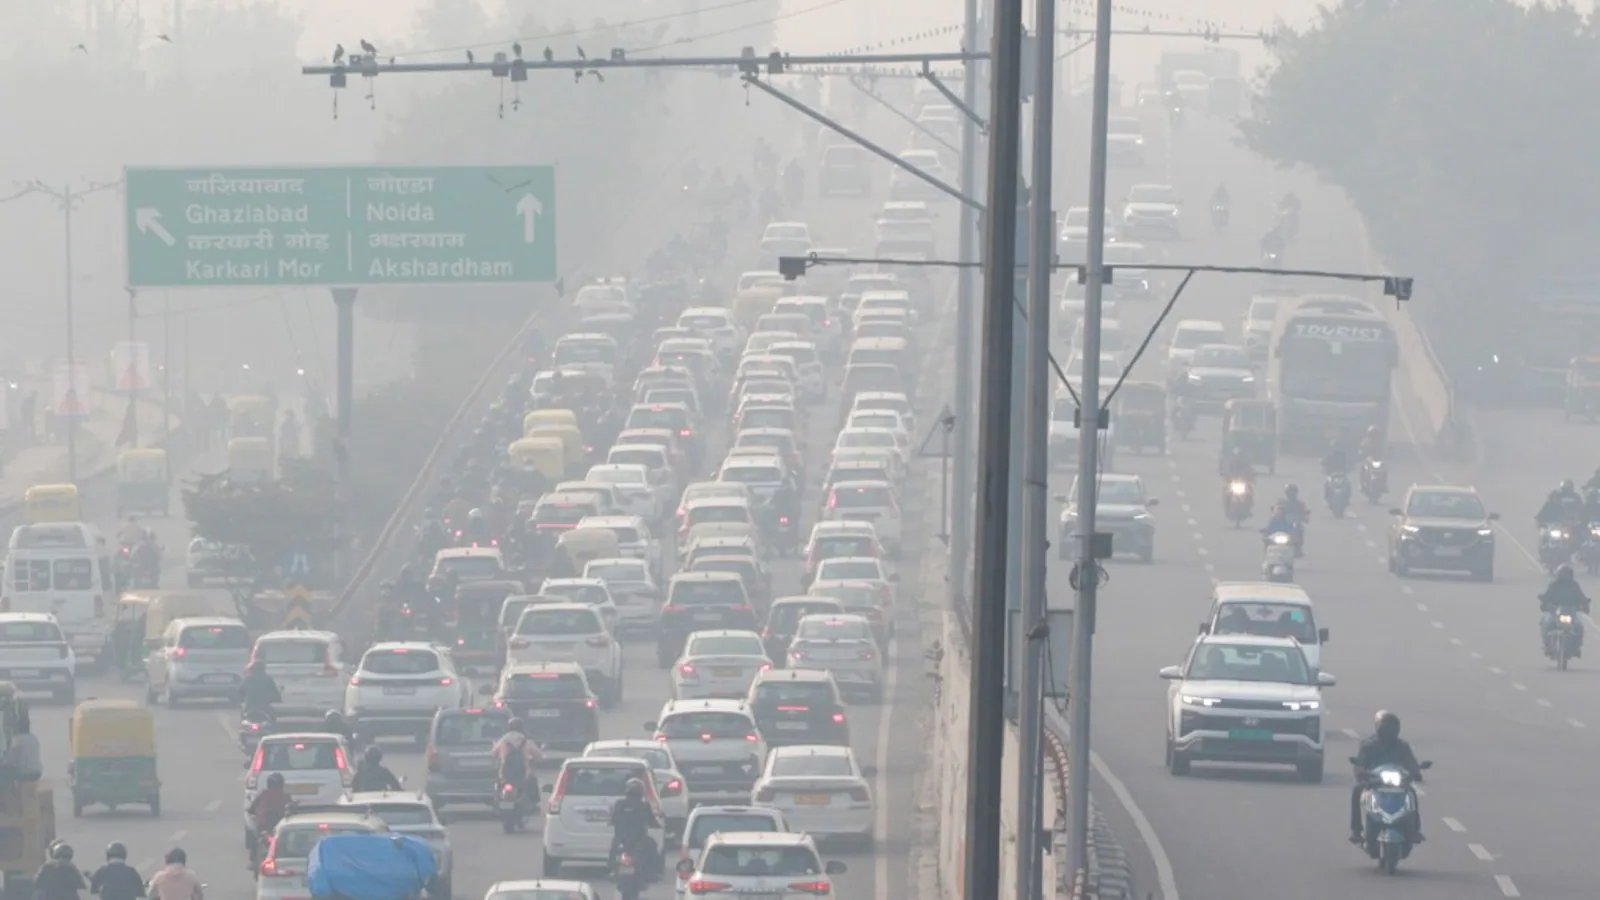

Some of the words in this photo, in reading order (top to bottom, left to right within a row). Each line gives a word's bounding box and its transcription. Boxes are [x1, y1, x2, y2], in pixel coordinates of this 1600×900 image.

[185, 203, 309, 224] Ghaziabad
[367, 202, 435, 222] Noida
[186, 258, 269, 280] Karkari
[278, 258, 324, 279] Mor
[368, 257, 515, 278] Akshardham
[1296, 324, 1382, 340] TOURIST
